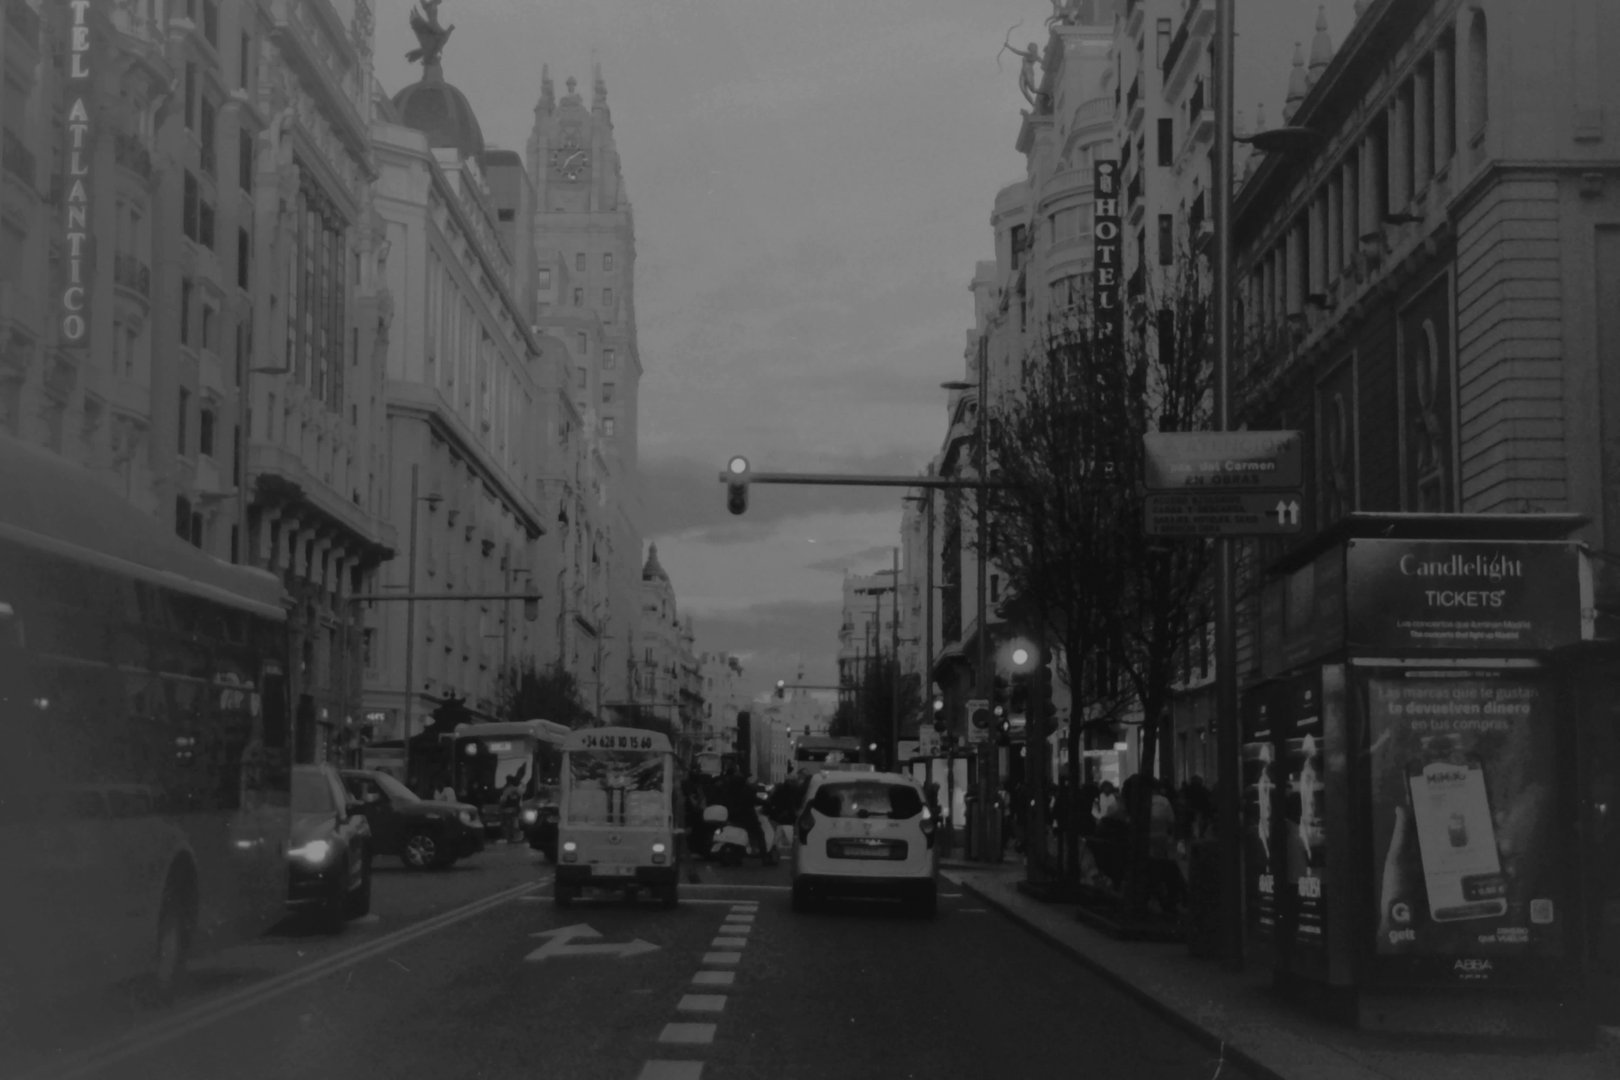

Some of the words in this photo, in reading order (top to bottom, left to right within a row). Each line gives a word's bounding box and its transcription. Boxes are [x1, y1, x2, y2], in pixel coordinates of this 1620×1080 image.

[70, 0, 90, 78] TEL
[63, 97, 89, 339] ATLANTICO
[1095, 198, 1117, 309] HOTEL
[1225, 460, 1275, 472] Carmen
[1211, 475, 1260, 485] OBRAS
[1400, 551, 1522, 583] Candlelight
[1379, 687, 1400, 699] Las
[1403, 688, 1450, 699] marcas
[1452, 688, 1478, 701] que
[1481, 687, 1493, 699] te
[1496, 687, 1538, 701] gustan
[1388, 702, 1403, 714] te
[1406, 702, 1480, 714] devuelven
[1483, 702, 1531, 714] dinero
[1411, 720, 1427, 730] en
[1430, 719, 1450, 730] tus
[1453, 720, 1508, 732] compras
[1453, 959, 1493, 970] ABBA
